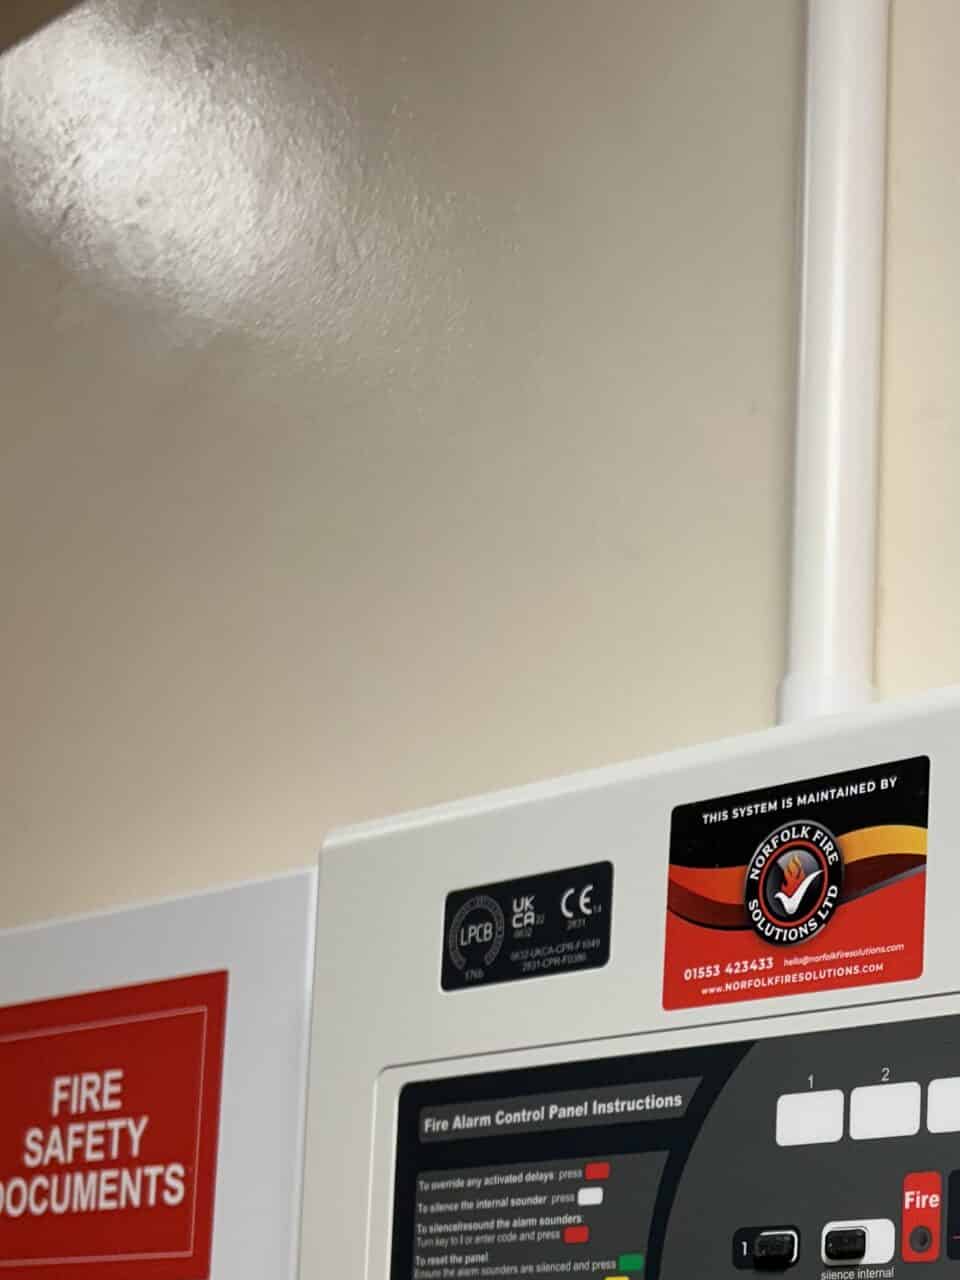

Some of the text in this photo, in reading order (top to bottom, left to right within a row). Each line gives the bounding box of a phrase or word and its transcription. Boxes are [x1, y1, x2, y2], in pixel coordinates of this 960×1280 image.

[702, 777, 898, 824] THIS SYSTEM IS MAINTAINED BY
[750, 826, 840, 881] NORFOLK FIRE
[512, 896, 535, 912] UK
[748, 884, 839, 941] SOLUTIONS LTD
[460, 922, 493, 946] LPCB
[684, 964, 721, 981] 01553
[725, 956, 774, 975] 423433
[52, 1069, 123, 1117] FIRE
[807, 1075, 814, 1089] 1
[881, 1068, 890, 1082] 2
[424, 1093, 683, 1133] Fire Alarm Control Panel Instructions
[24, 1115, 149, 1168] SAFETY
[0, 1163, 185, 1217] OCUMENTS
[904, 1191, 941, 1209] Fire
[742, 1241, 748, 1256] 1
[821, 1267, 894, 1280] silence internal
